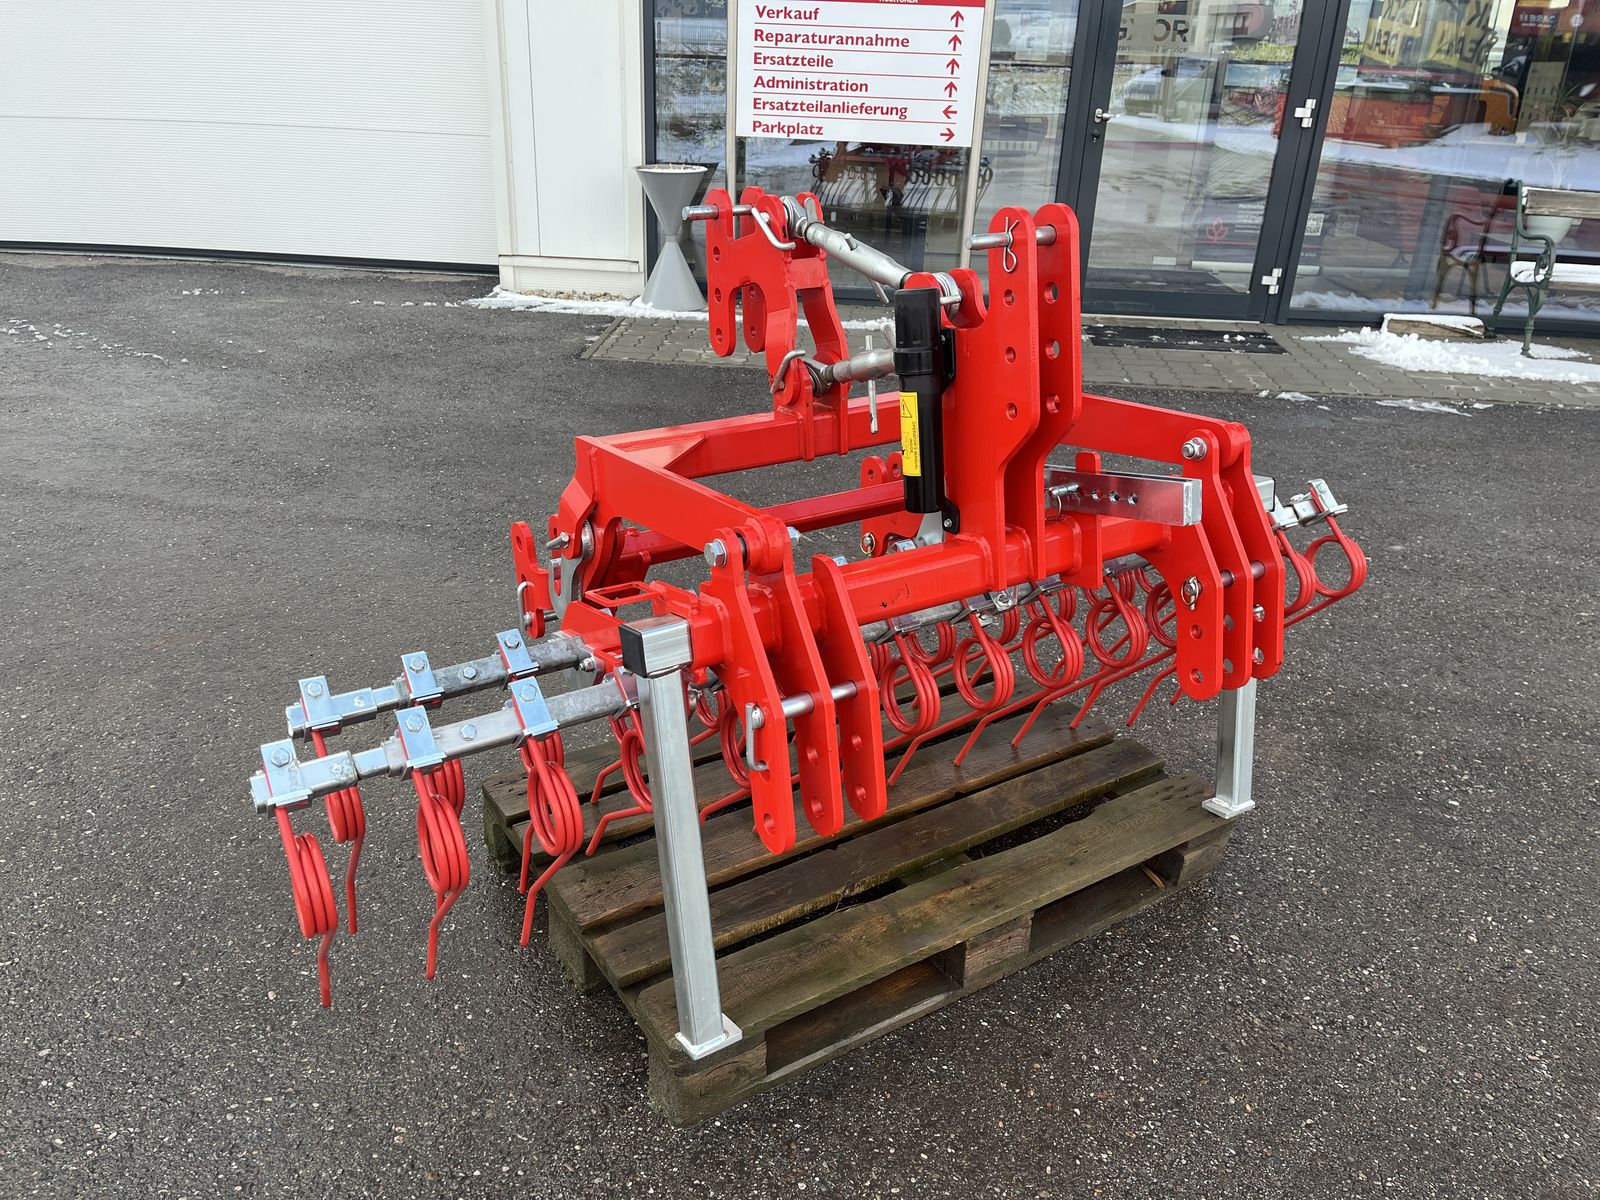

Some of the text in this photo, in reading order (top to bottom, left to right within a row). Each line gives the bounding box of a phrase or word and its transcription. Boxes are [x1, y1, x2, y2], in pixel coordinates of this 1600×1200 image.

[755, 4, 820, 21] Verkauf
[753, 28, 910, 48] Reparaturannahme
[752, 51, 834, 68] Ersatzteile
[753, 74, 869, 93] Administration
[752, 97, 908, 120] Ersatzteilanlieferung
[752, 120, 824, 137] Parkplatz
